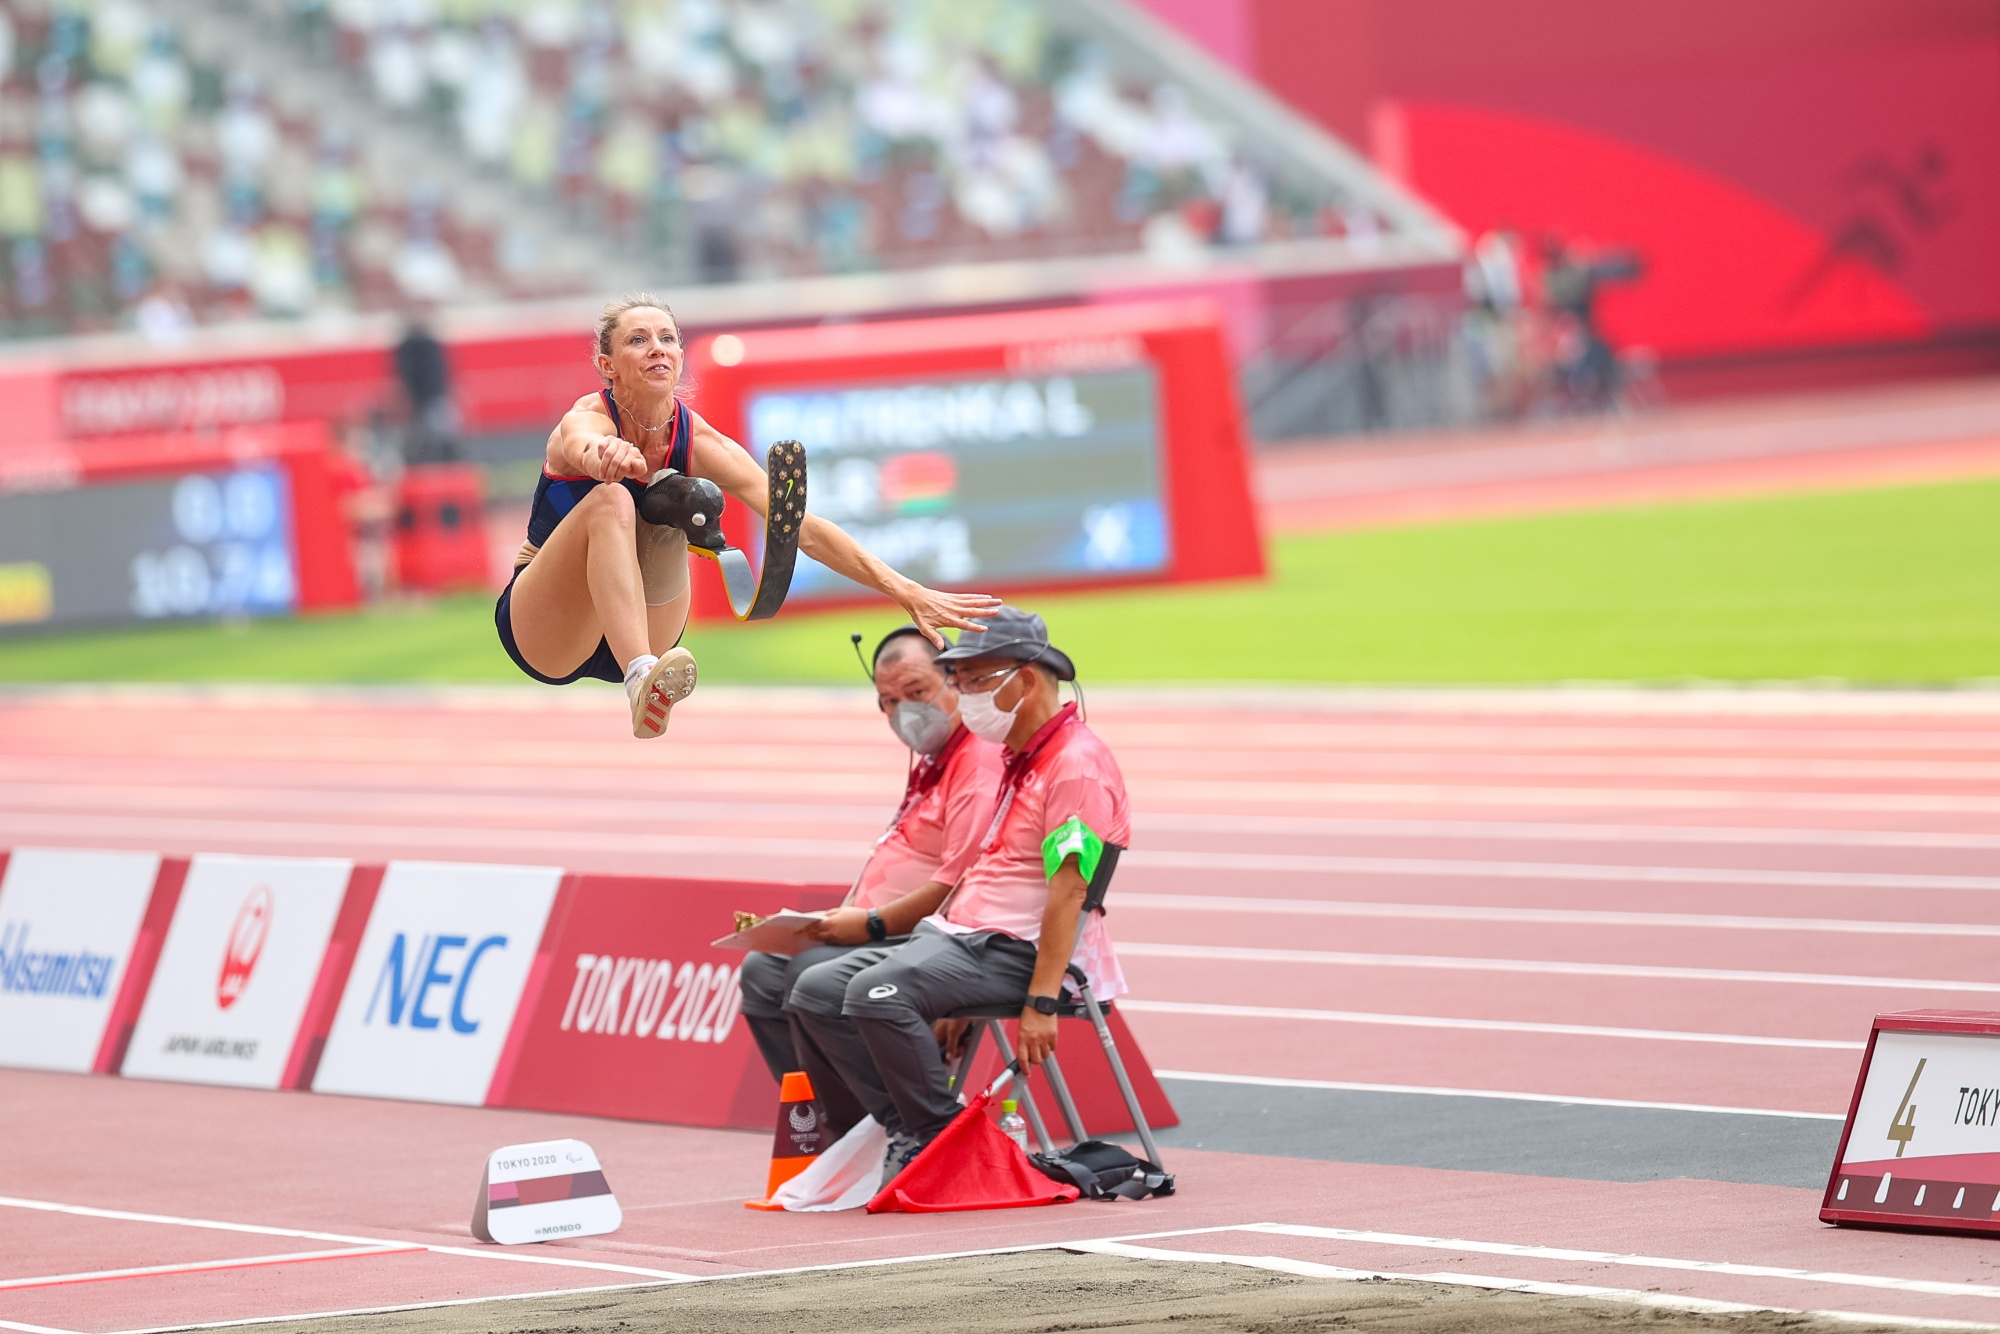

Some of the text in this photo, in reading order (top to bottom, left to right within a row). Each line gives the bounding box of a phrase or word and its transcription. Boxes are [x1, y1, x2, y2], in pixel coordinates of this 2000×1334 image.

[364, 933, 508, 1034] NEC
[560, 953, 744, 1044] TOKYO 2020
[1887, 1058, 1927, 1157] 4
[497, 1154, 557, 1171] TOKYO 2020
[542, 1223, 582, 1235] MONDO
